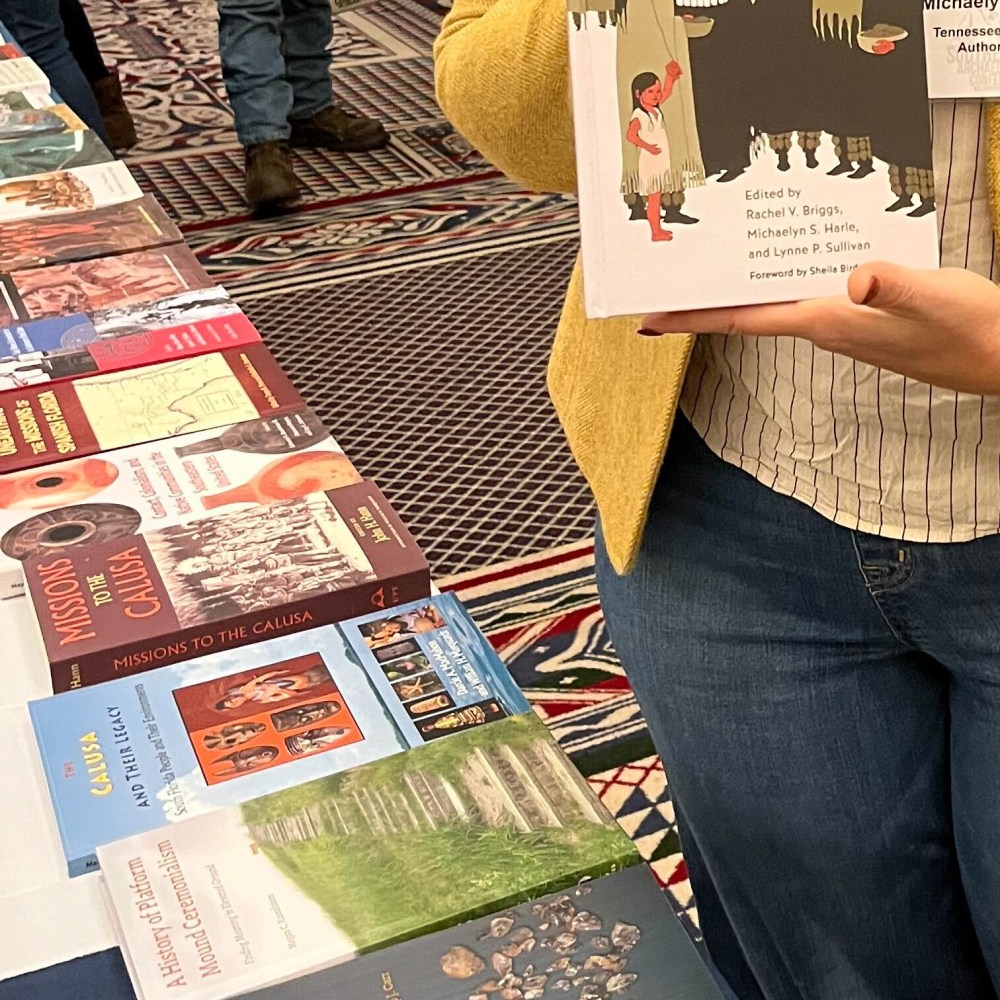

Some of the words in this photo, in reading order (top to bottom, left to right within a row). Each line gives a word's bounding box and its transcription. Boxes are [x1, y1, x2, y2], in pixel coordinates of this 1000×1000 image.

[933, 26, 1000, 38] Tennessee
[745, 188, 784, 201] Edited
[788, 187, 802, 199] by
[746, 207, 786, 220] Rachel
[788, 206, 800, 217] V.
[803, 205, 843, 217] Briggs,
[747, 226, 807, 239] Michaelyn
[809, 224, 821, 235] S.
[824, 222, 860, 234] Harle,
[748, 247, 770, 259] and
[774, 246, 809, 259] Lynne
[812, 243, 823, 254] P.
[825, 241, 871, 253] Sullivan
[749, 268, 794, 280] Foreword
[796, 267, 808, 278] by
[809, 265, 838, 276] Sheila
[37, 390, 64, 423] FLORIDA
[14, 407, 44, 444] MISSIONS
[48, 420, 78, 454] SPANISH
[30, 440, 47, 455] THE
[86, 572, 109, 592] THE
[107, 547, 162, 618] CALUSA
[37, 558, 96, 646] MISSIONS
[92, 591, 113, 607] TO
[113, 641, 188, 671] MISSIONS
[191, 634, 214, 650] TO
[217, 626, 248, 644] THE
[252, 610, 314, 634] CALUSA
[70, 663, 82, 689] Hann
[106, 705, 129, 745] LEGACY
[146, 722, 161, 742] Their
[62, 761, 76, 779] THE
[79, 731, 114, 797] CALUSA
[120, 746, 141, 782] THEIR
[155, 751, 172, 774] People
[131, 783, 151, 808] AND
[128, 856, 158, 913] Platform
[157, 839, 201, 929] Ceremonialism
[140, 912, 163, 925] of
[152, 926, 182, 978] History
[185, 929, 222, 978] Mound
[166, 975, 187, 988] A
